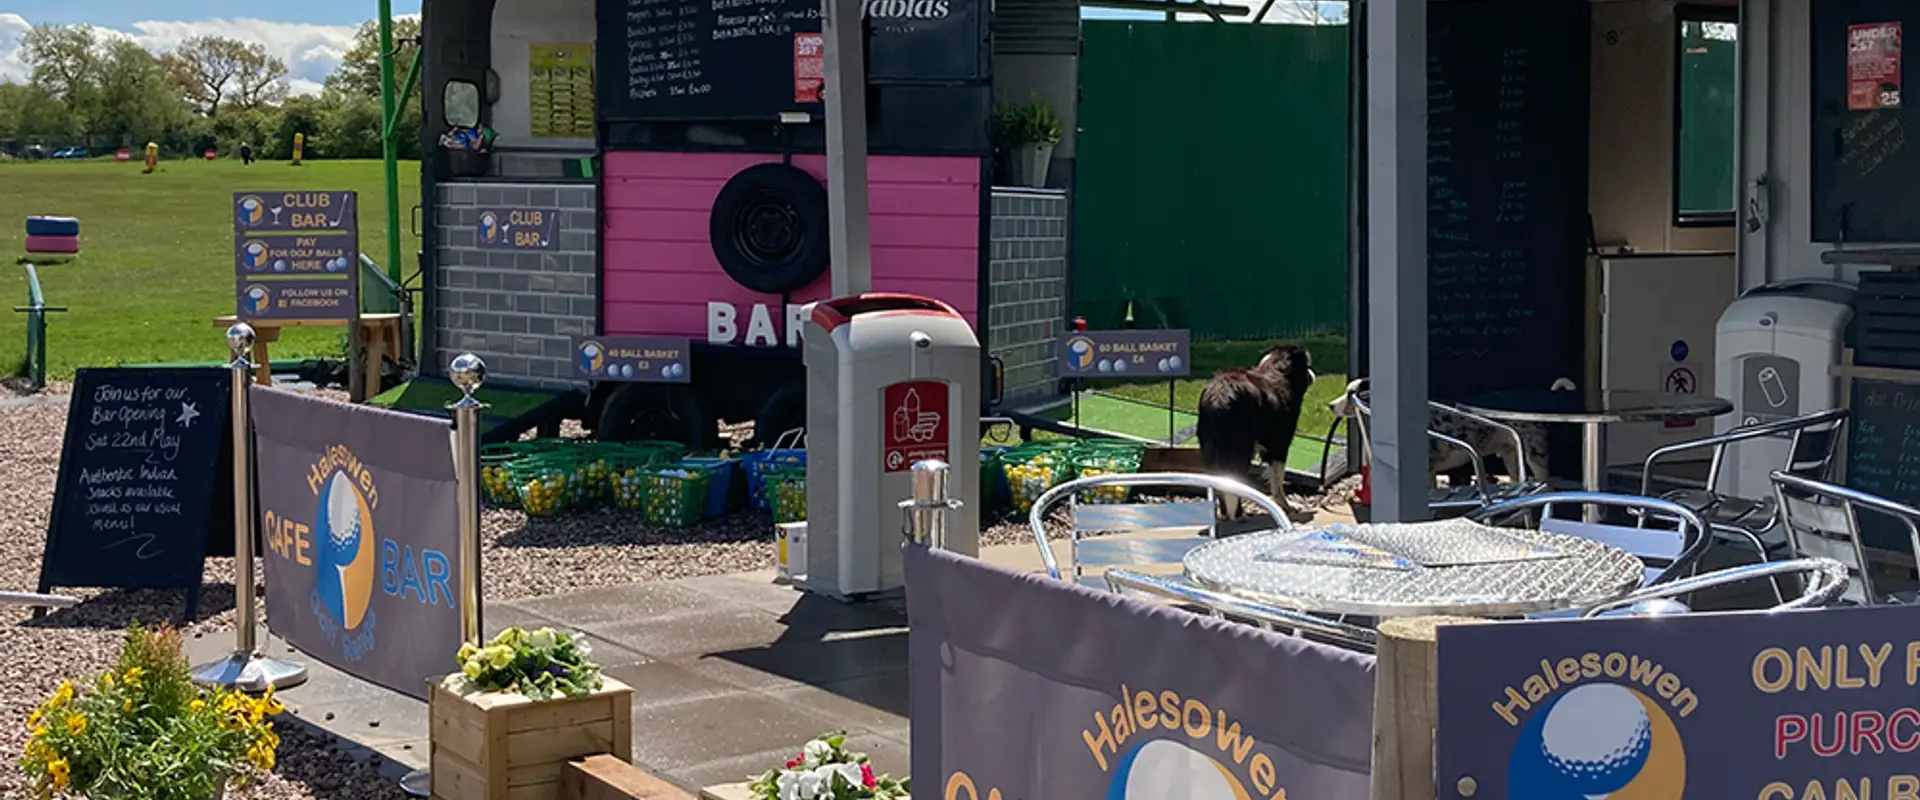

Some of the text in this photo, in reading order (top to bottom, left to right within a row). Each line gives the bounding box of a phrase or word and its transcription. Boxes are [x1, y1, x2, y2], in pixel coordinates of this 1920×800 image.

[798, 36, 823, 46] UND
[1852, 26, 1897, 41] UNDER
[1879, 91, 1900, 106] 25
[283, 193, 330, 208] CLUB
[291, 213, 327, 228] BAR
[509, 210, 543, 226] CLUB
[296, 237, 317, 247] PAY
[515, 231, 540, 248] BAR
[269, 249, 343, 257] FOR GOLF BALLS
[291, 260, 322, 271] HERE
[281, 288, 348, 297] FOLLOW US ON
[290, 298, 339, 308] FACEBOOK
[707, 301, 804, 347] BAR
[620, 349, 643, 359] BALL
[644, 349, 680, 360] BASKET
[1113, 342, 1137, 353] BALL
[1139, 341, 1178, 352] BASKET
[94, 384, 188, 403] Join us for our
[90, 404, 167, 432] Bar Opening
[84, 427, 182, 461] Sat 22nd May
[306, 443, 380, 510] Halesowen
[264, 510, 313, 567] CAFE
[381, 538, 455, 609] BAR
[1752, 642, 1893, 693] ONLY
[1491, 650, 1700, 727] Halesowen
[1775, 708, 1920, 759] PURC
